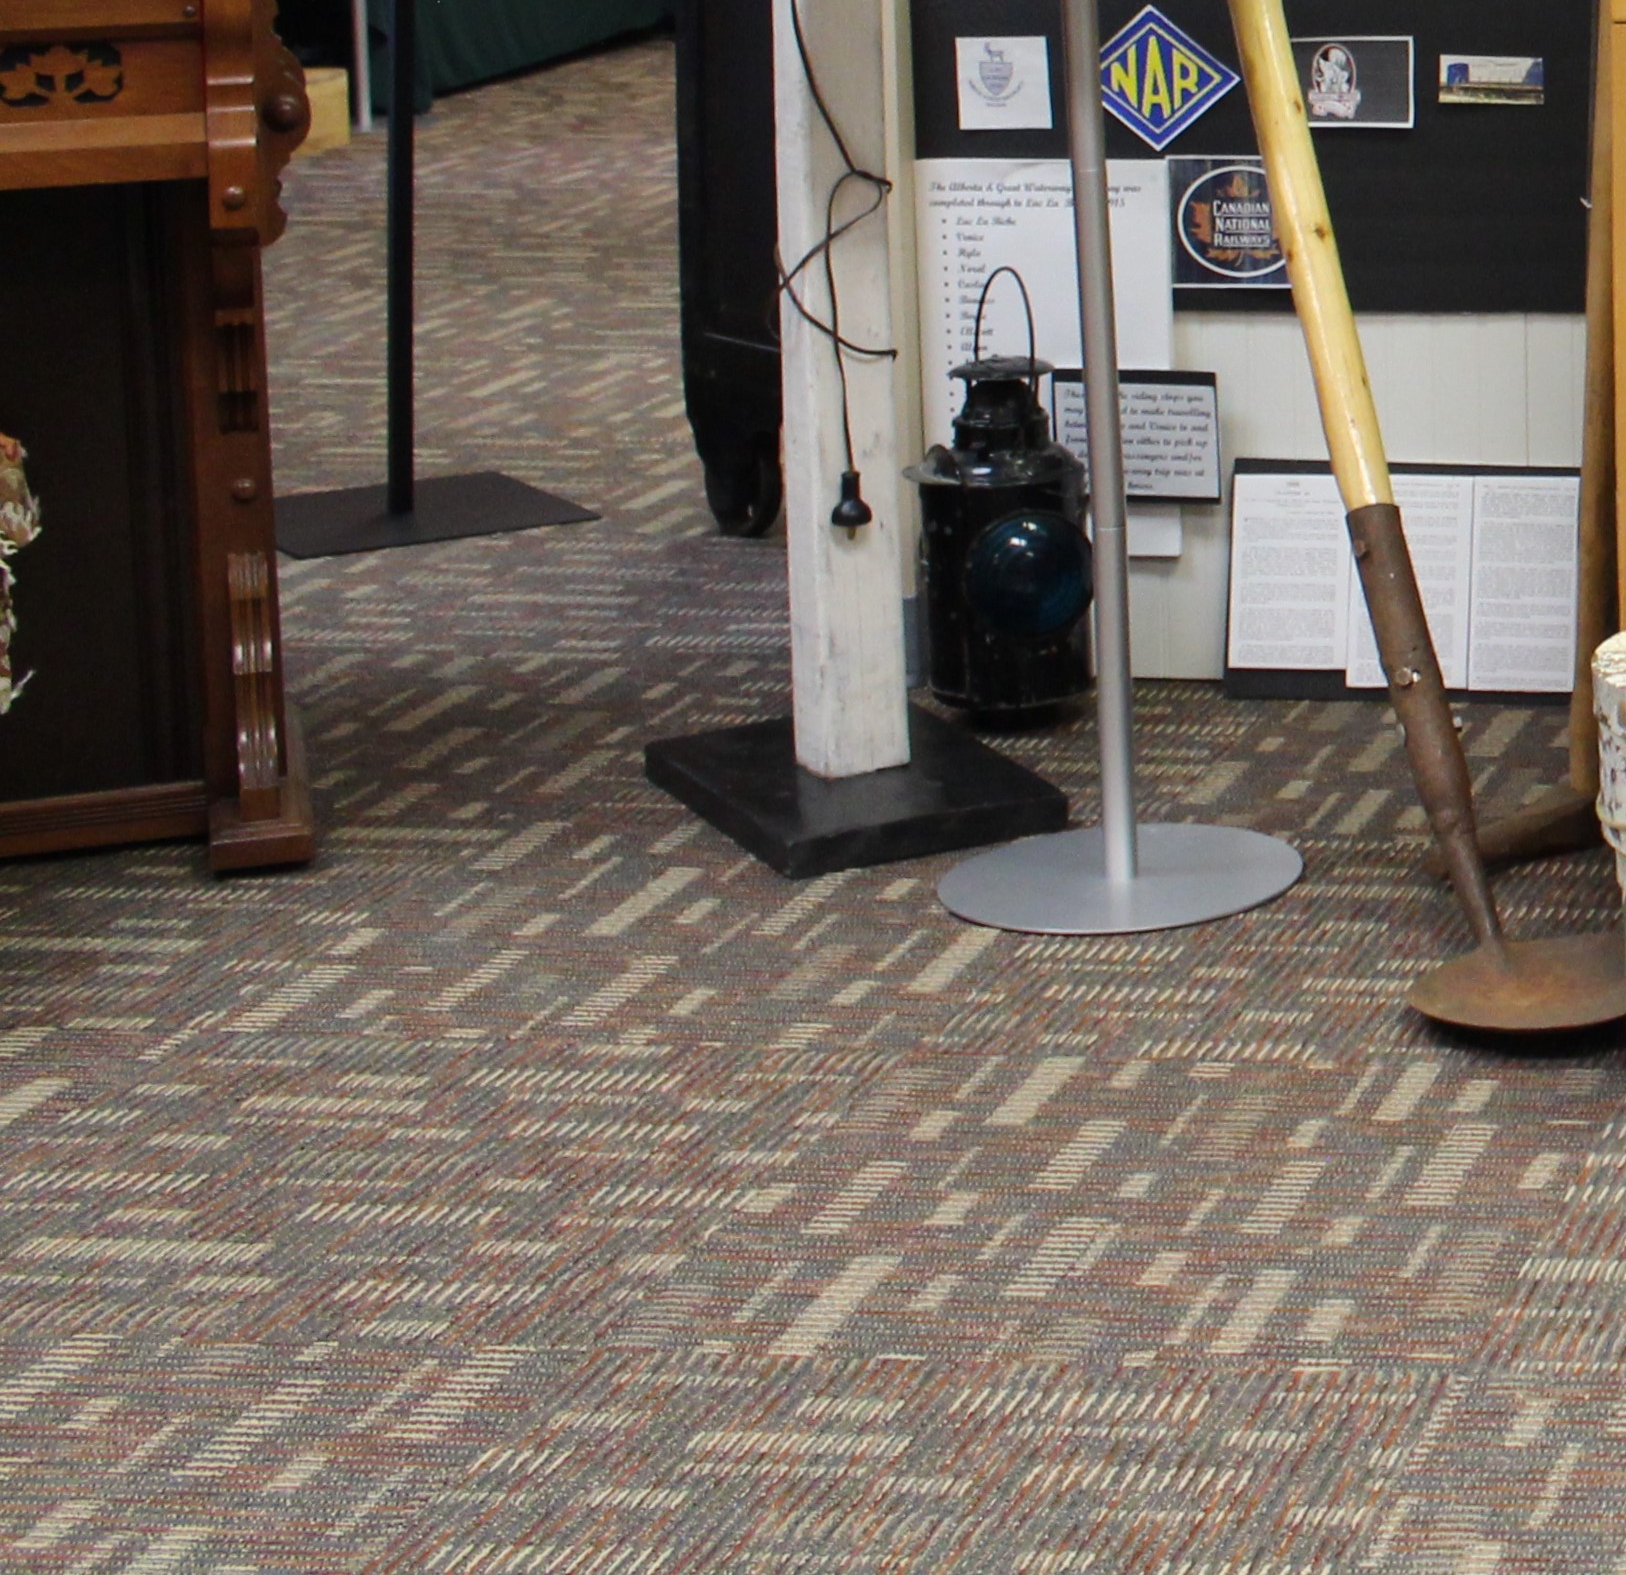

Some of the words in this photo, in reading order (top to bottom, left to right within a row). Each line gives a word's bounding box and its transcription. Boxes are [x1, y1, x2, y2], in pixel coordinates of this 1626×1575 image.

[1110, 35, 1198, 119] NAR
[1213, 200, 1270, 216] CANADIAN
[1215, 216, 1270, 232] NATIONAL
[1214, 232, 1270, 248] RAILWAYS
